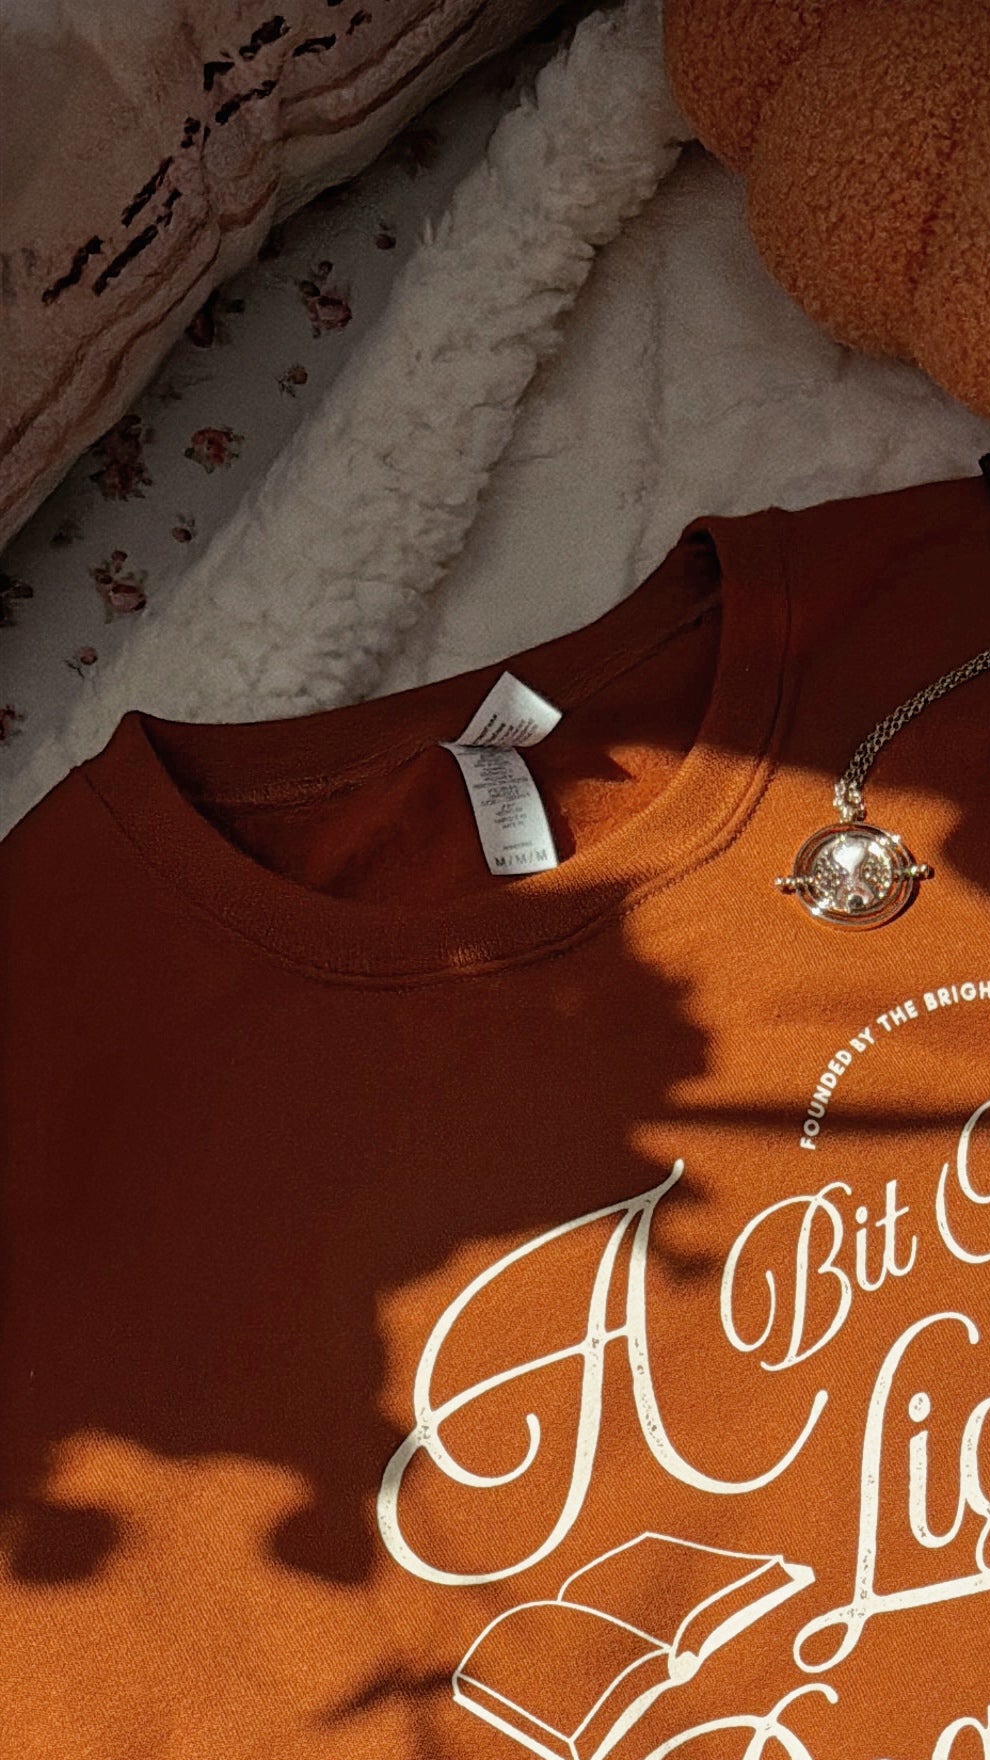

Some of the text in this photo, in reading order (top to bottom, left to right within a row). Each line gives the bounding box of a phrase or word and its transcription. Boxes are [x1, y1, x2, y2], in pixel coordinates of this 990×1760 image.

[800, 1049, 853, 1151] FOUNDED
[849, 1026, 875, 1053] BY
[876, 999, 919, 1032] THE
[376, 1158, 829, 1586] A
[720, 1178, 919, 1373] Bit
